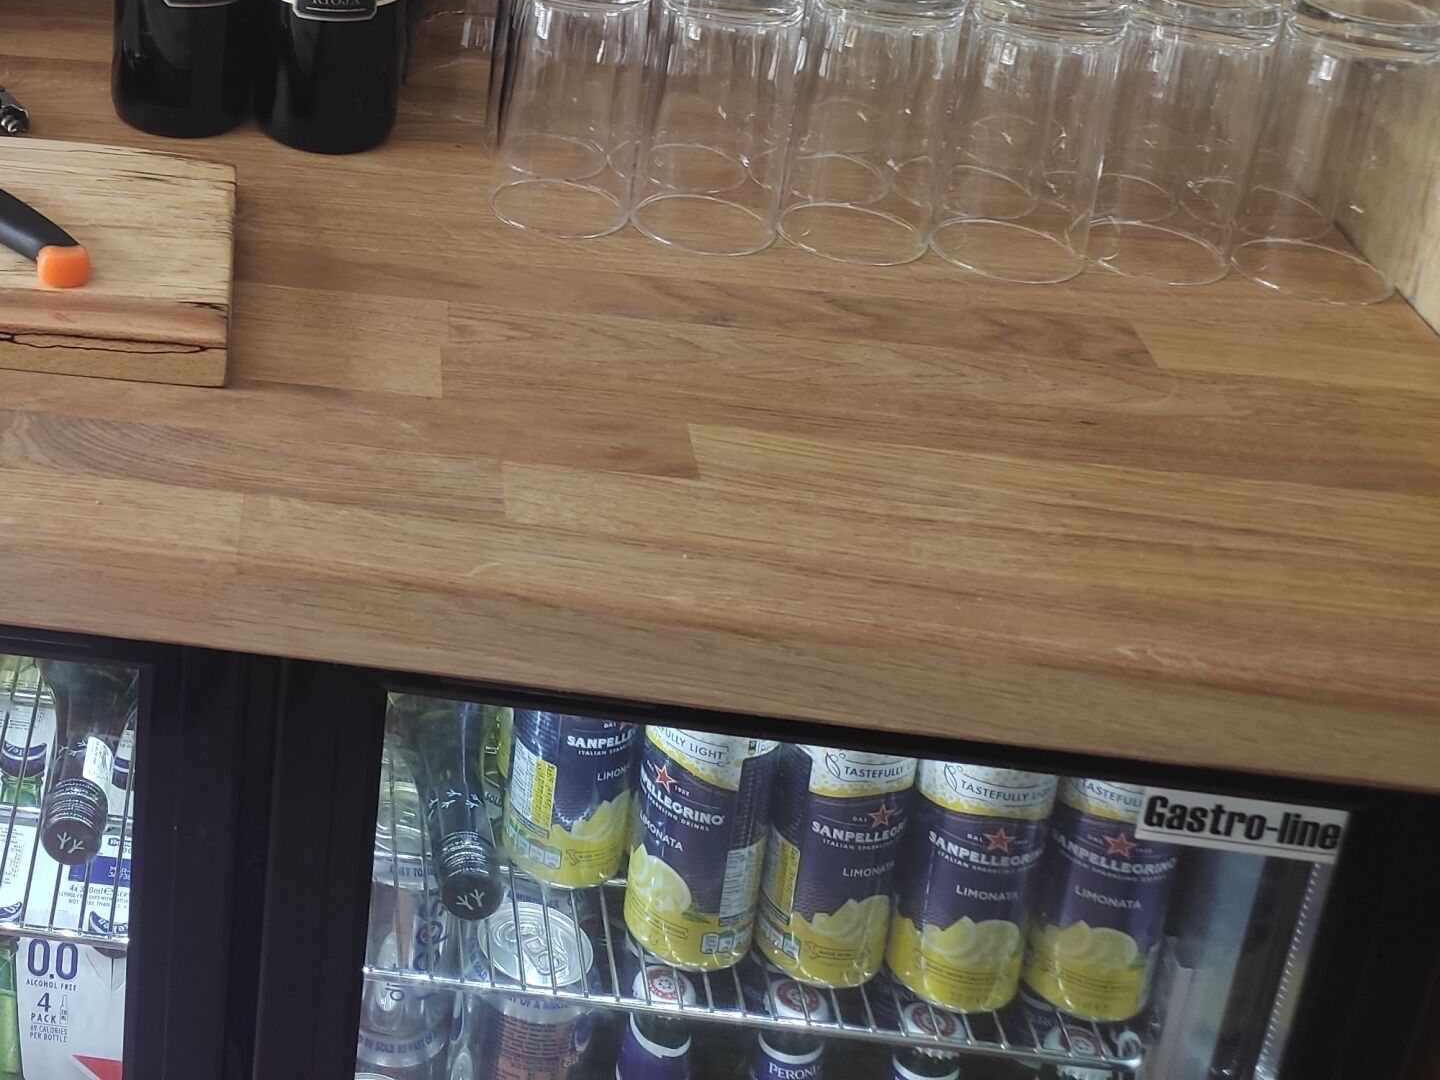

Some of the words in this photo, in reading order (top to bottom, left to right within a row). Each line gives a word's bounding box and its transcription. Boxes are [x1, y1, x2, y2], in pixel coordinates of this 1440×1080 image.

[689, 742, 723, 760] LIGHT
[843, 764, 905, 778] TASTEFULLY
[960, 780, 1030, 802] TASTEFULLY
[1143, 795, 1342, 850] Gastro-line
[956, 884, 1019, 901] LIMONATA
[1074, 885, 1142, 910] LIMONATA
[27, 938, 78, 980] 0.0
[26, 978, 58, 990] ALCOHOL
[60, 983, 77, 992] FREE
[36, 992, 52, 1012] 4
[30, 1012, 57, 1024] PACK
[29, 1032, 42, 1040] PER
[44, 1033, 68, 1043] BOTTLE
[39, 1026, 68, 1036] CALORIES
